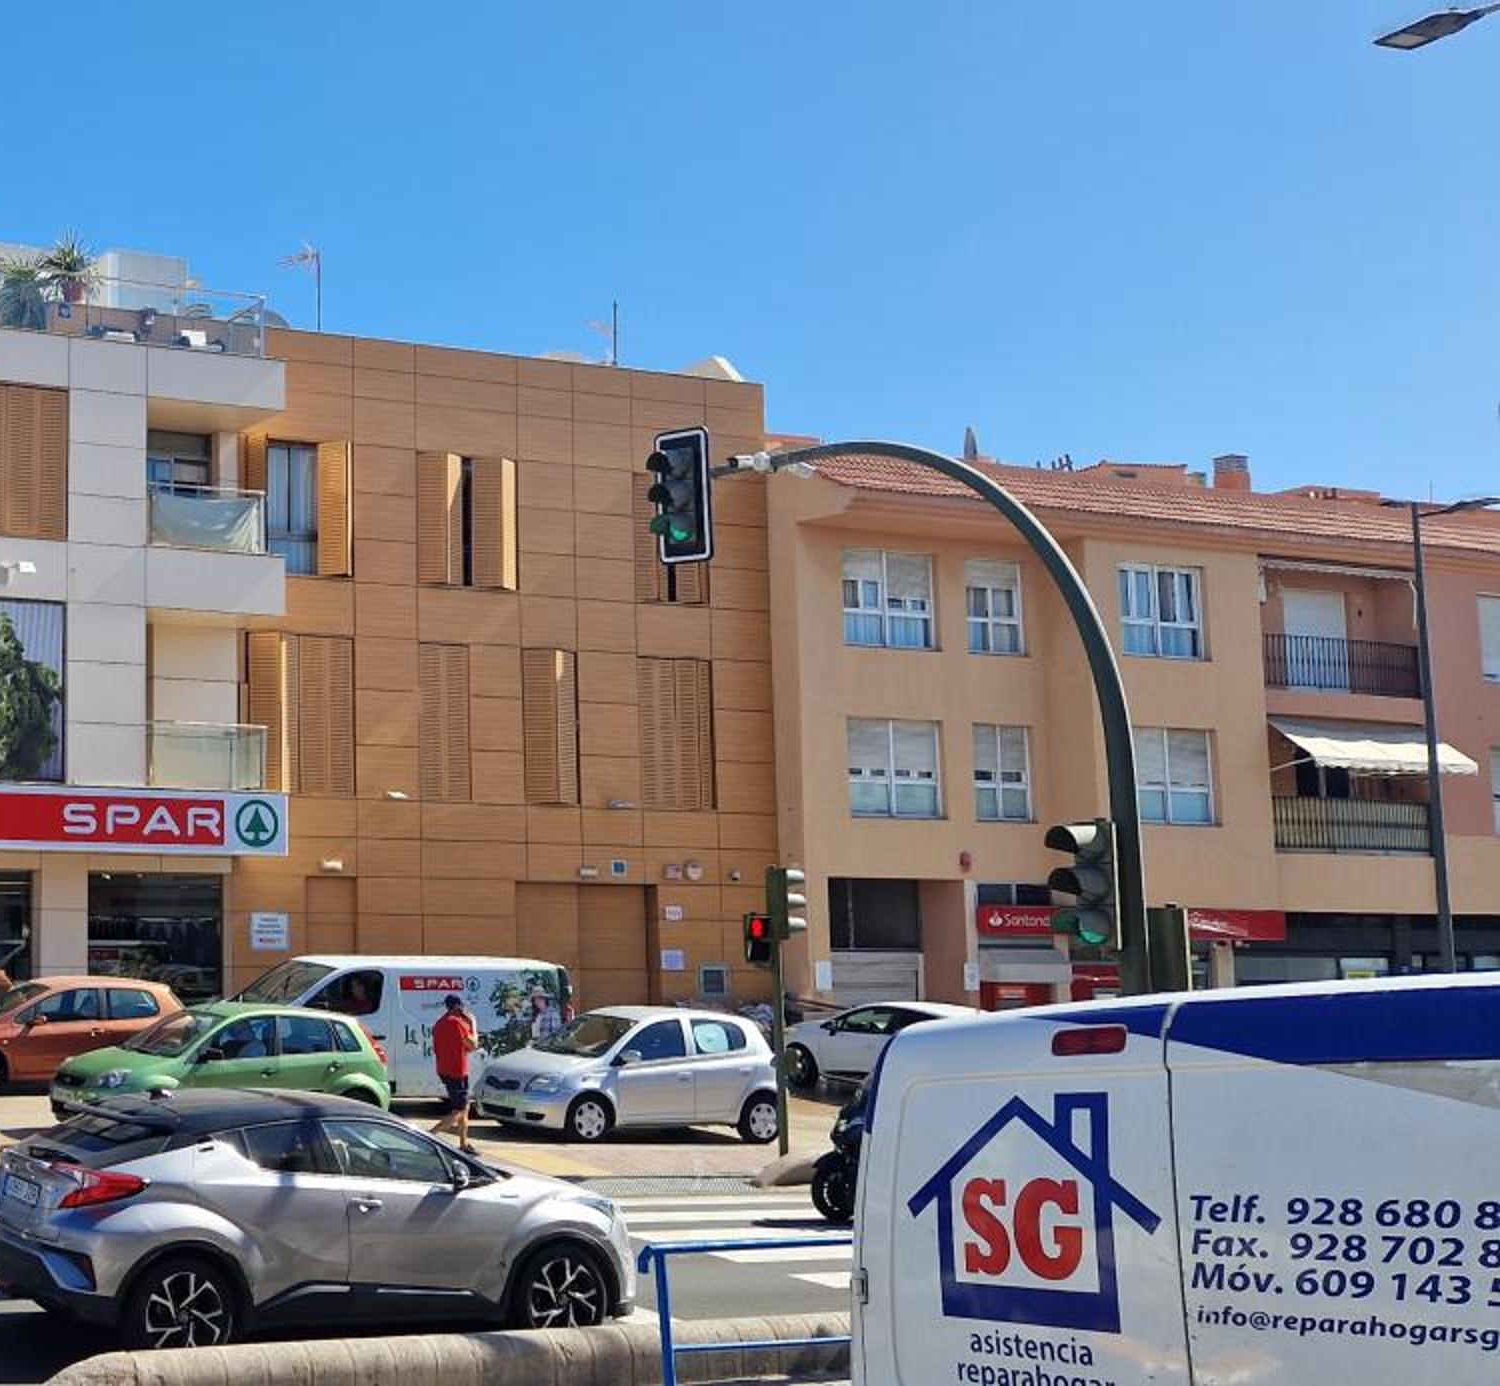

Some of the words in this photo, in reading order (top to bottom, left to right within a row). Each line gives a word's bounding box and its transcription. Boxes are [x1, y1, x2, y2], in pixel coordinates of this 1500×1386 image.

[62, 803, 222, 838] SPAR
[414, 979, 463, 989] SPAR
[962, 1177, 1083, 1281] SG
[1190, 1195, 1265, 1224] Telf.
[1287, 1197, 1363, 1226] 928
[1375, 1199, 1461, 1229] 680
[1192, 1229, 1268, 1258] Fax.
[1289, 1233, 1367, 1262] 928
[1381, 1235, 1465, 1266] 702
[1191, 1262, 1283, 1294] Móv.
[1295, 1269, 1375, 1299] 609
[1391, 1273, 1472, 1305] 143
[1197, 1305, 1500, 1351] info@reparahogarsg
[970, 1329, 1093, 1366] asistencia
